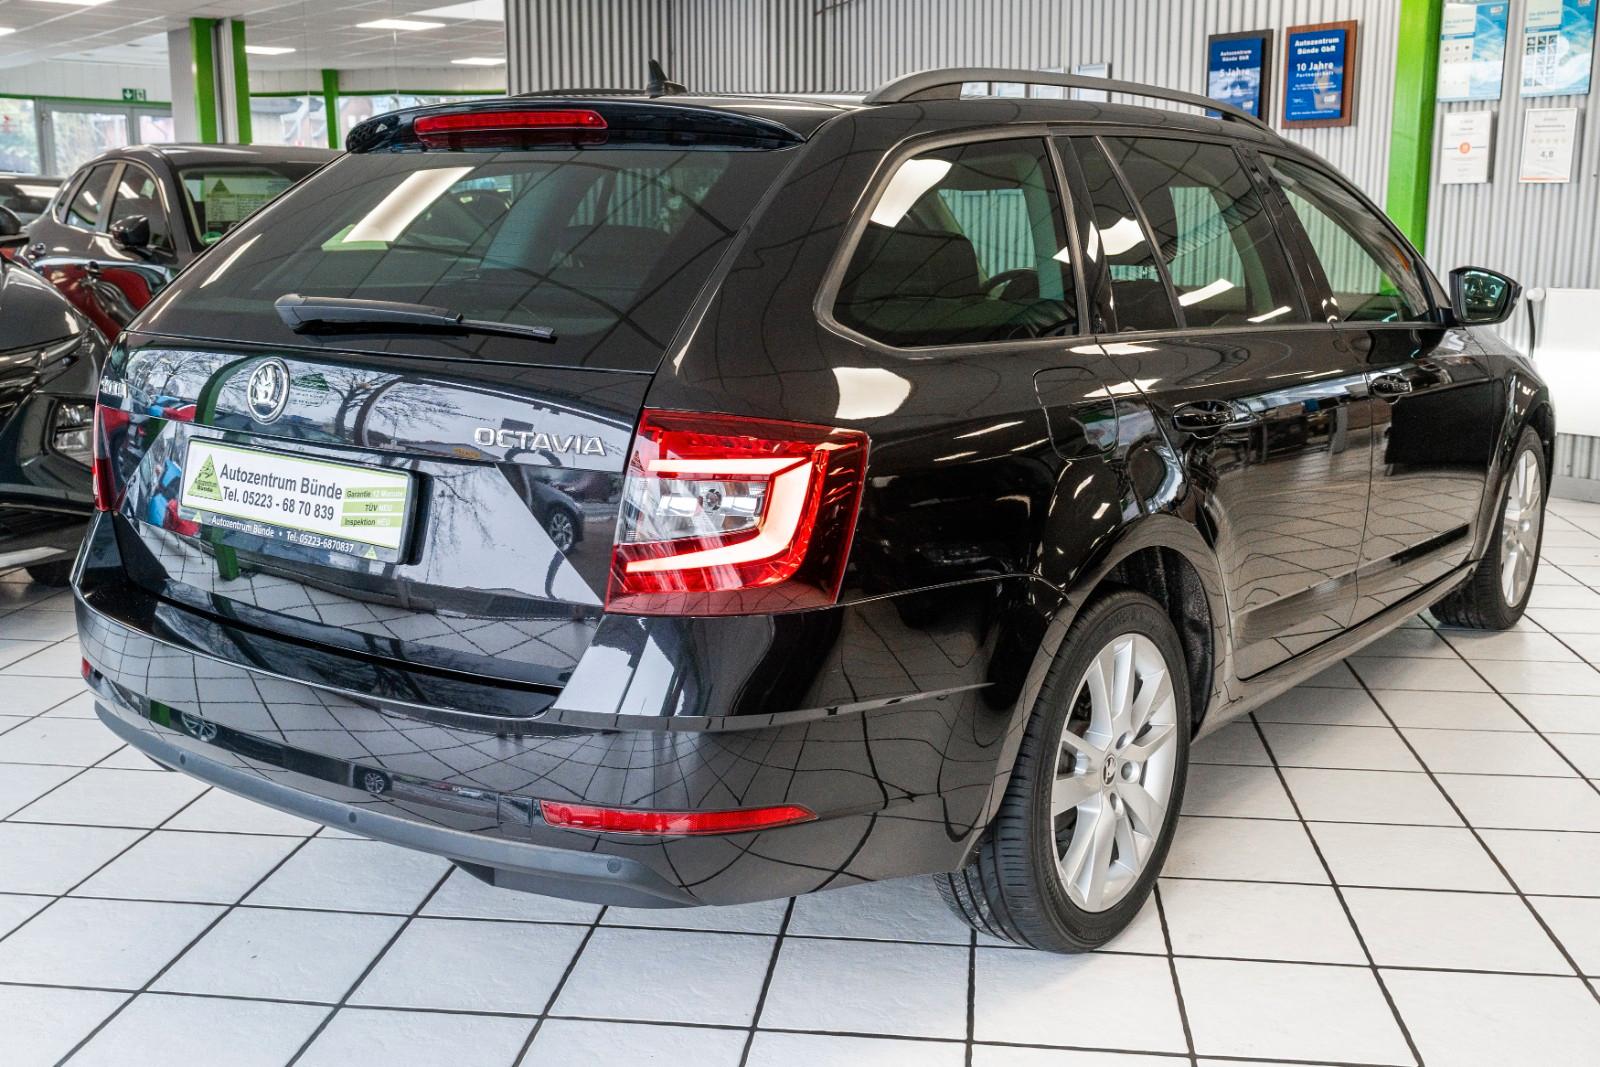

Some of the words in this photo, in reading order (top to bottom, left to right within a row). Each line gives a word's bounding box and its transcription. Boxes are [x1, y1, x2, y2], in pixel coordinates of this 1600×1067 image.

[1294, 37, 1340, 47] Autozentrum
[1297, 46, 1319, 55] Bünde
[1321, 45, 1336, 53] GbR
[1219, 68, 1225, 77] 5
[1226, 66, 1250, 76] Jahre
[1296, 62, 1307, 72] 10
[1309, 60, 1334, 71] Jahre
[474, 427, 606, 456] OCTAVIA
[220, 463, 297, 492] Autozentrum
[300, 476, 343, 500] Bünde
[346, 489, 371, 499] Garantie
[223, 486, 239, 503] Tel.
[242, 491, 273, 509] 05223
[282, 497, 295, 514] 68
[298, 500, 311, 517] 70
[314, 503, 334, 521] 839
[364, 503, 378, 512] TÜV
[344, 517, 376, 527] Inspektion
[211, 515, 252, 533] Autozentrum
[252, 523, 275, 538] Bünde
[286, 531, 298, 543] Tel.
[299, 533, 355, 554] 05223-6870837
